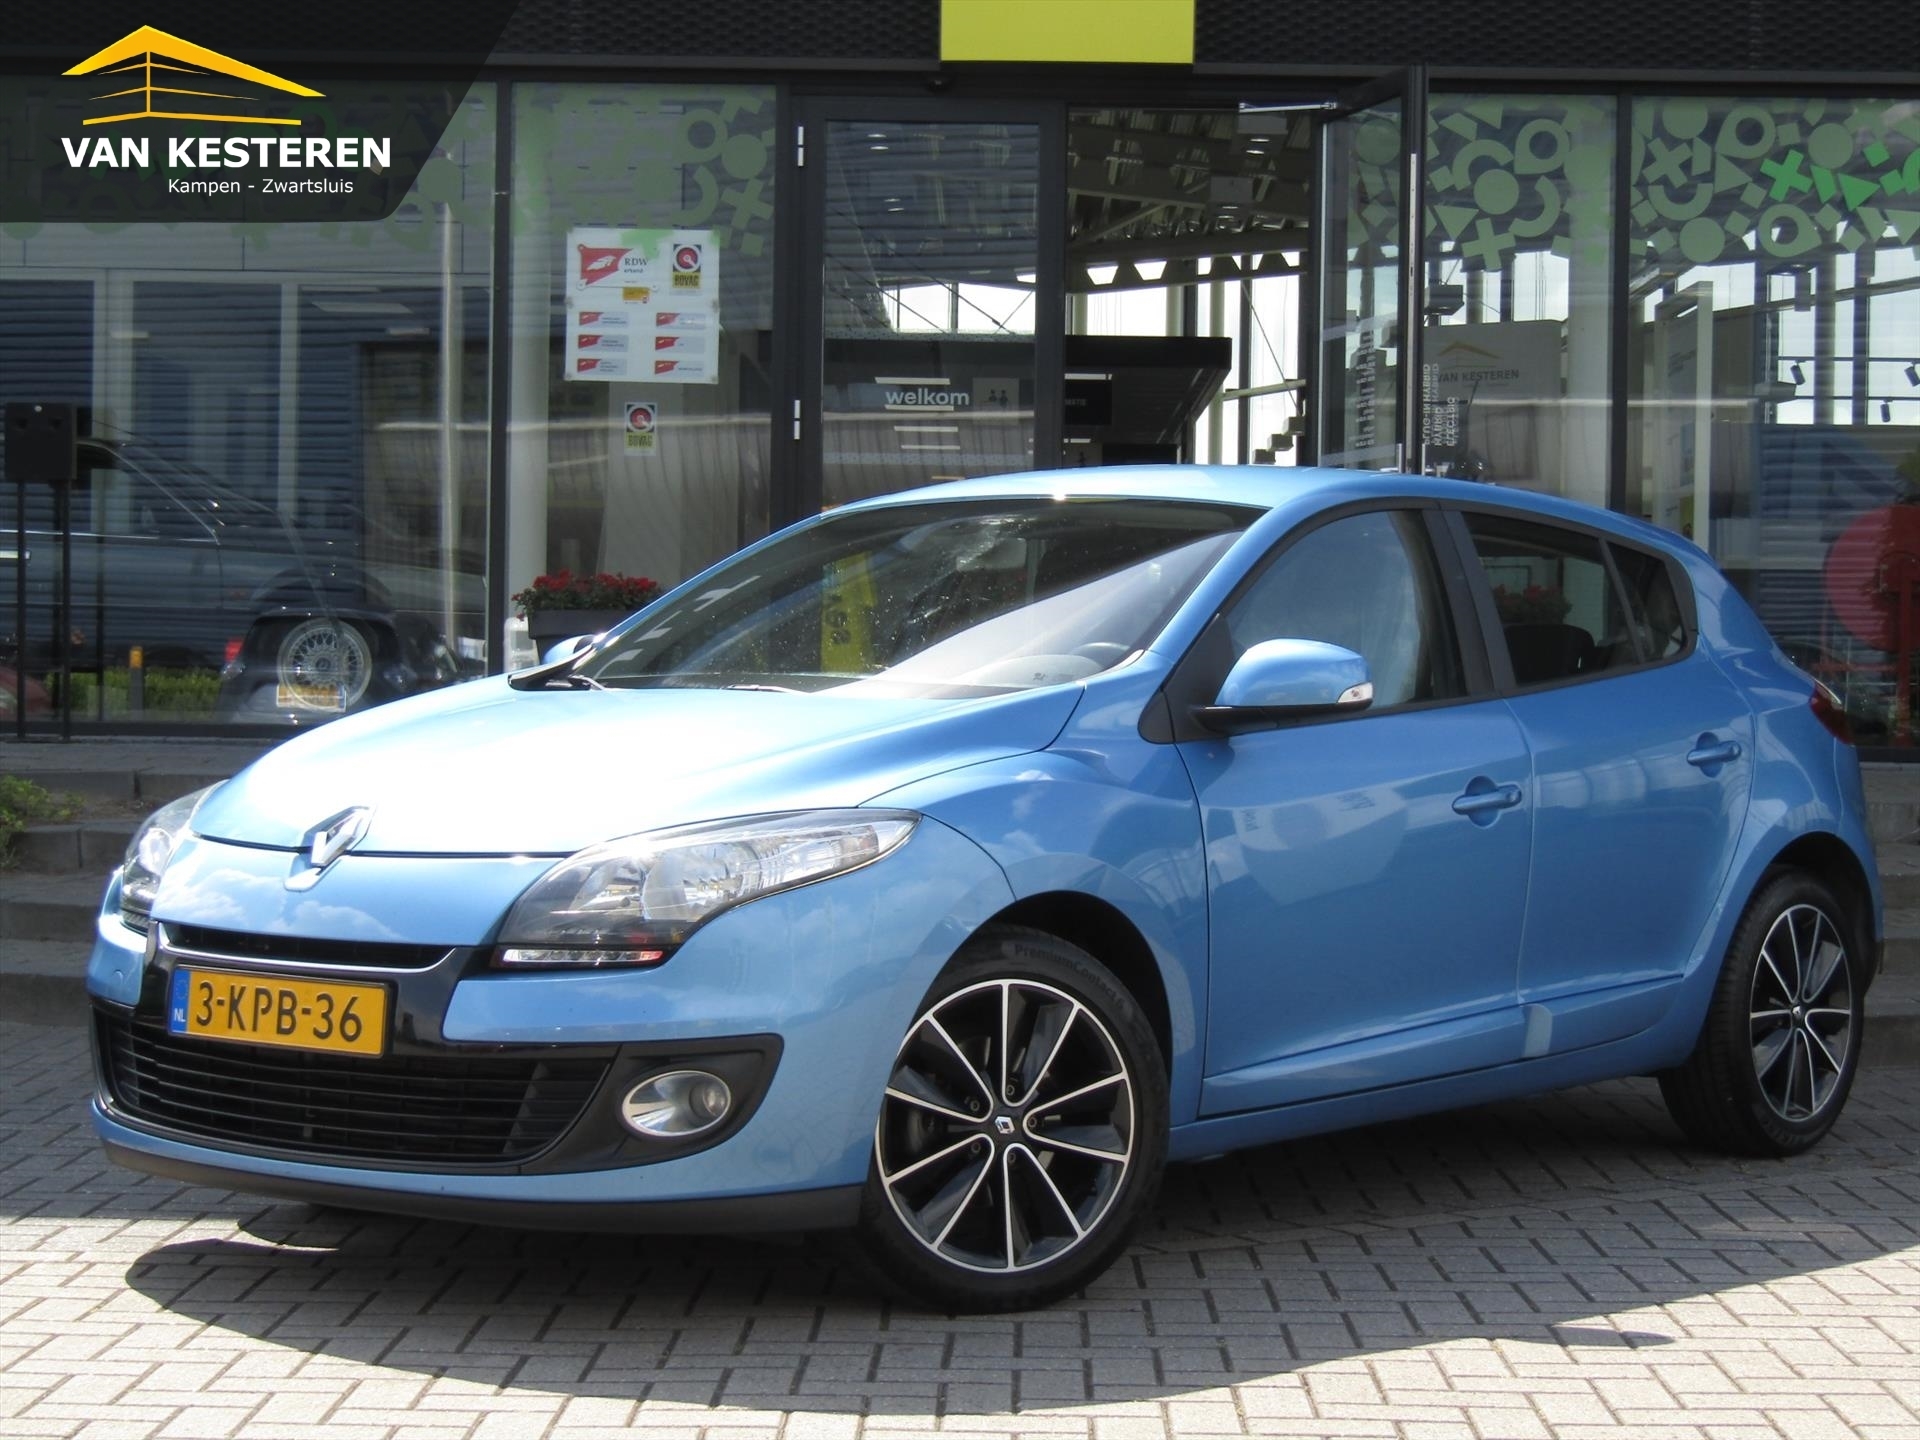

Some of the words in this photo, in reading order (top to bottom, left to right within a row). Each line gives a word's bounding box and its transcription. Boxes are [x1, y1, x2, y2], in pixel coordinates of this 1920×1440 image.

[624, 257, 648, 267] RDW
[674, 274, 700, 287] BOVAG
[1438, 372, 1459, 383] VAN
[1462, 369, 1519, 382] KESTEREN
[885, 387, 970, 406] welkom
[174, 1007, 187, 1023] NL
[196, 980, 363, 1043] 3-KPB-36
